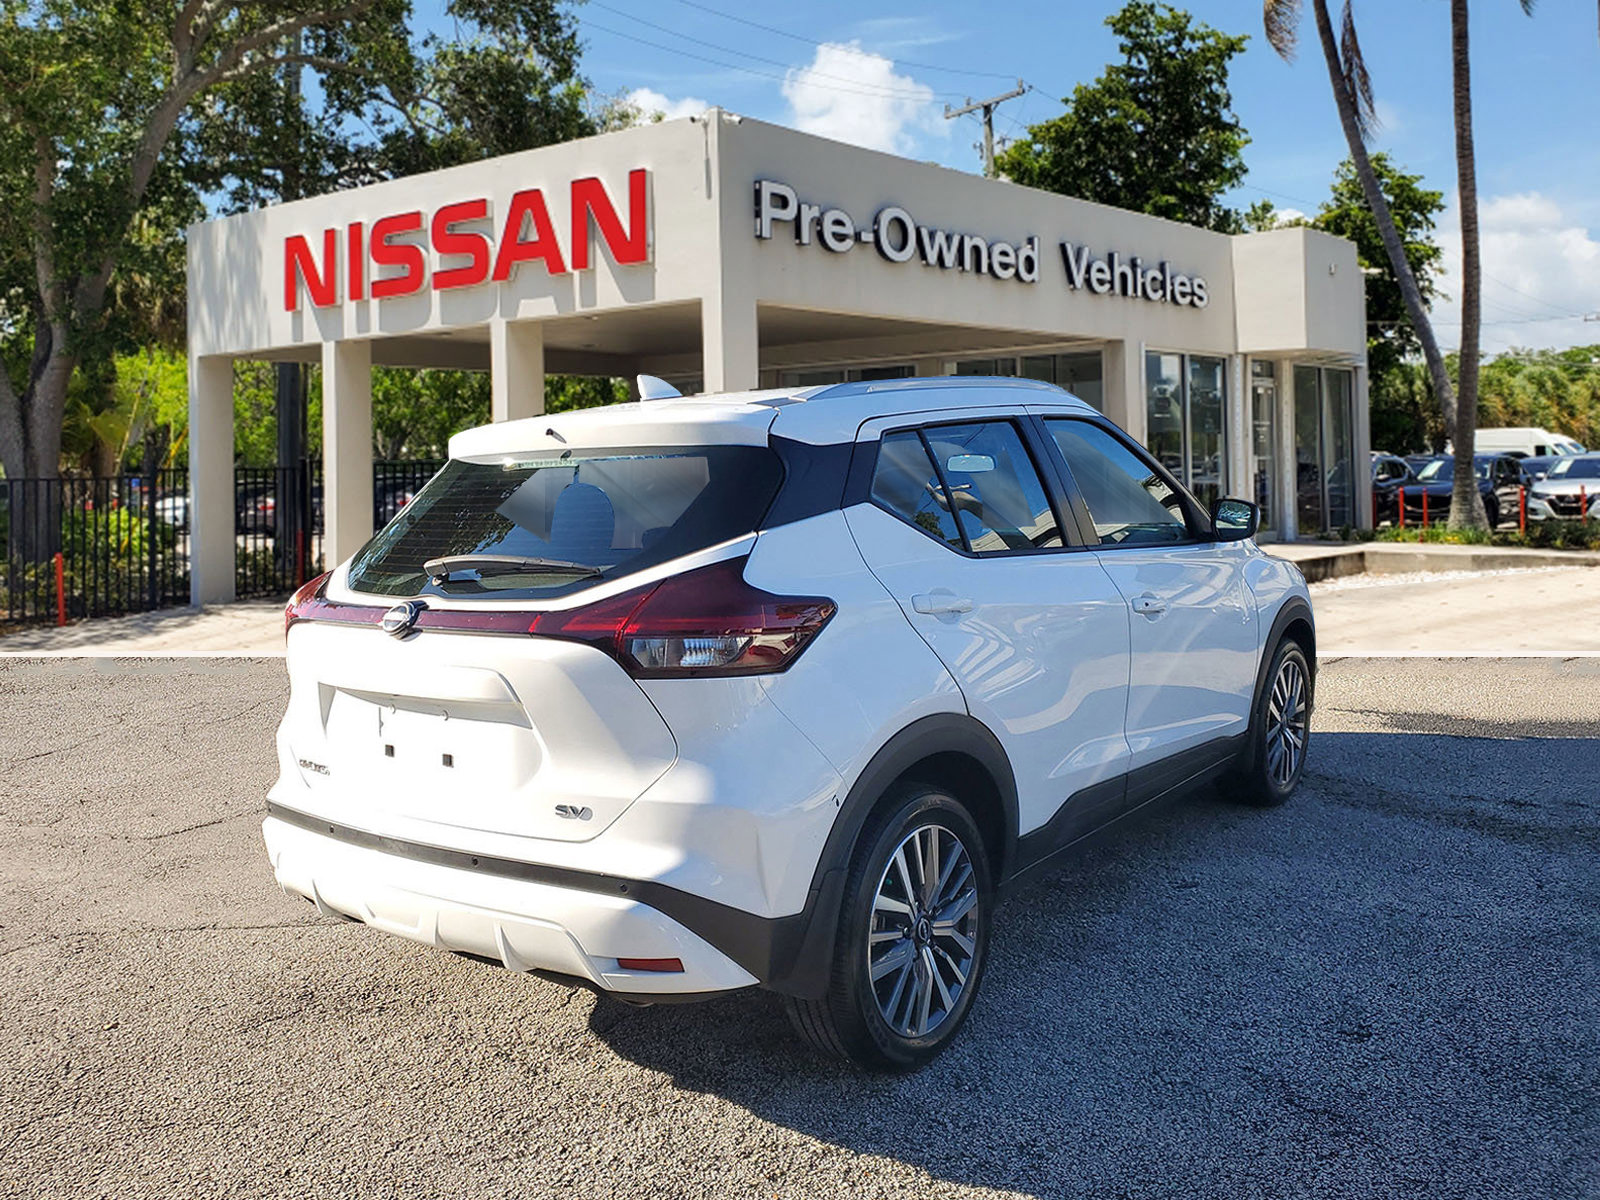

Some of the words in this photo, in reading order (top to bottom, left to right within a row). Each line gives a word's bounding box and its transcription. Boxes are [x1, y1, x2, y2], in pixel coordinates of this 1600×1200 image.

[285, 168, 648, 311] NISSAN
[755, 180, 1040, 283] Pre-Owned
[1062, 241, 1209, 309] Vehicles
[555, 804, 593, 821] SV
